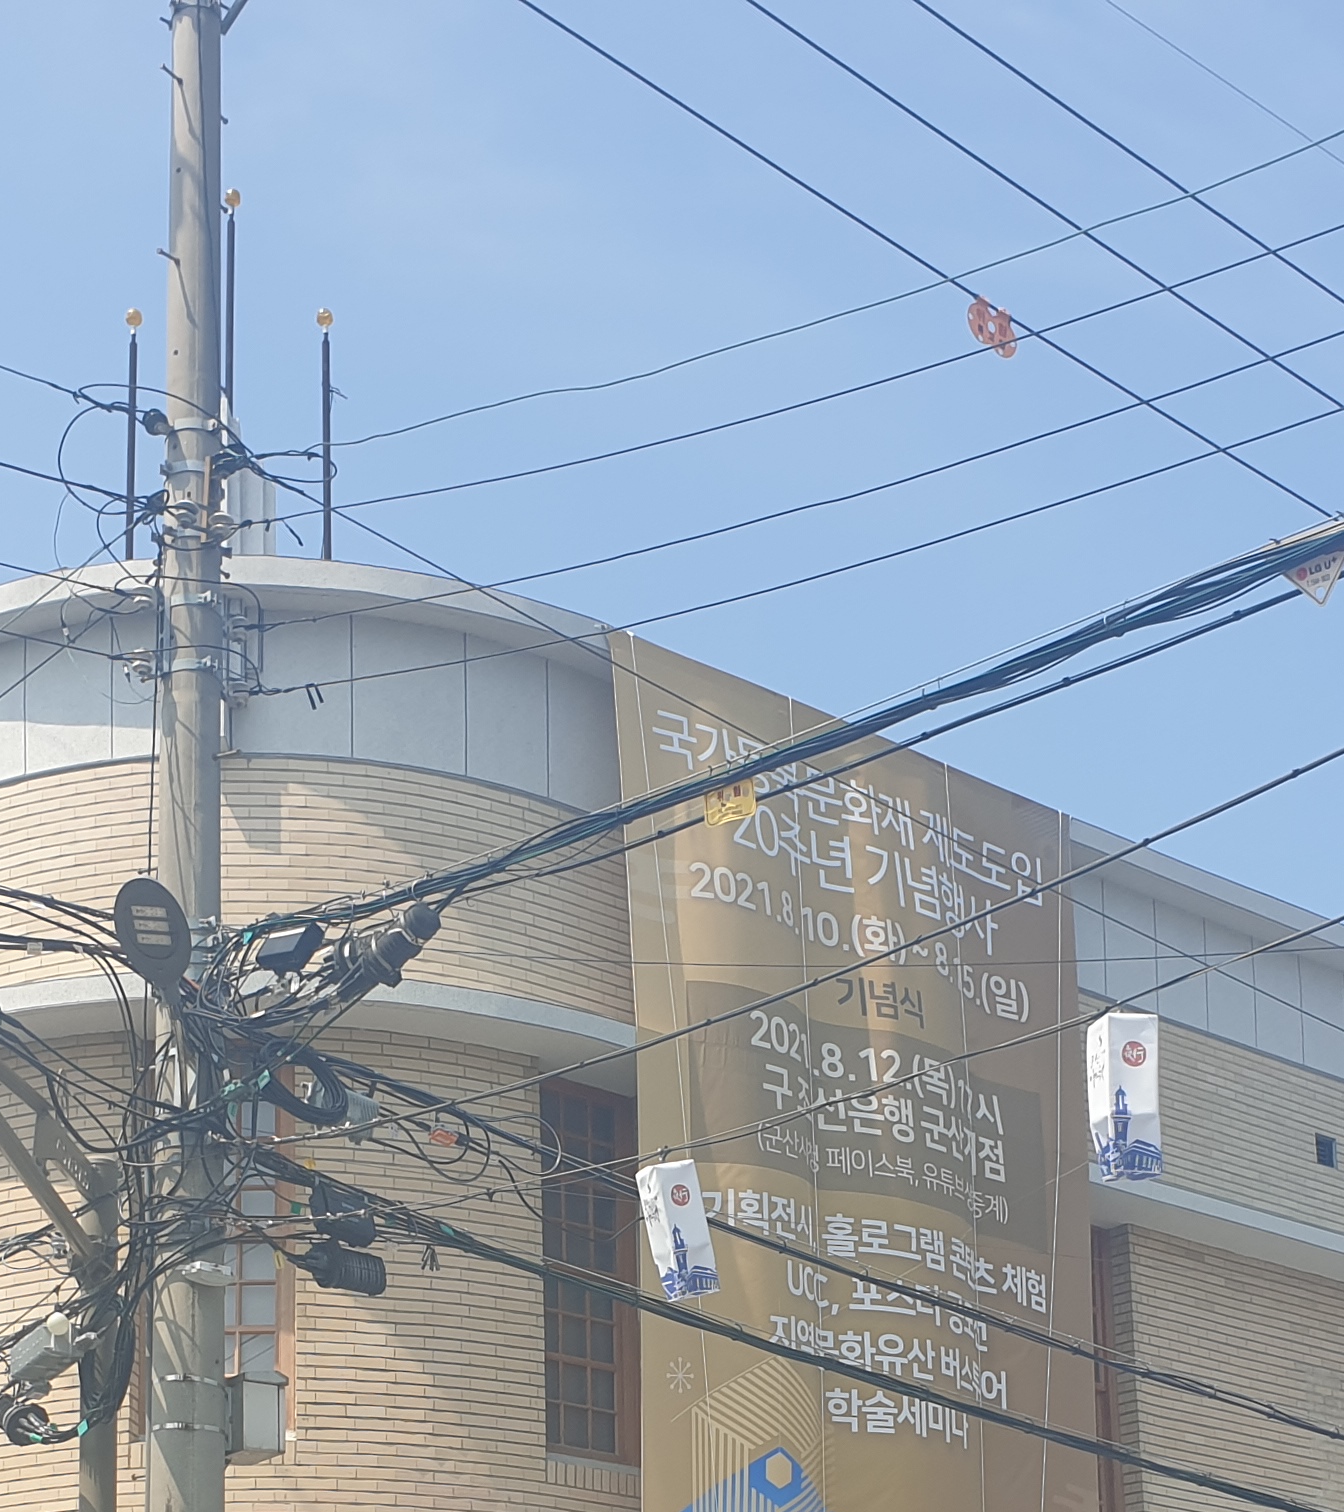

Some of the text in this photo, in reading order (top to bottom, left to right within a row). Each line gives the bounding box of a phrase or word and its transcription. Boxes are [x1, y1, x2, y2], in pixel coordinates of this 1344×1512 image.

[920, 810, 1043, 907] 제도도입
[864, 844, 999, 957] 기념행사
[836, 977, 925, 1030] 기념식
[762, 1063, 793, 1110] 구
[796, 1076, 915, 1143] 조선은행
[787, 1260, 839, 1315] UCC,
[822, 1213, 946, 1272] 홀로그램
[1002, 1263, 1047, 1314] 체험
[825, 1387, 969, 1449] 학술세미나
